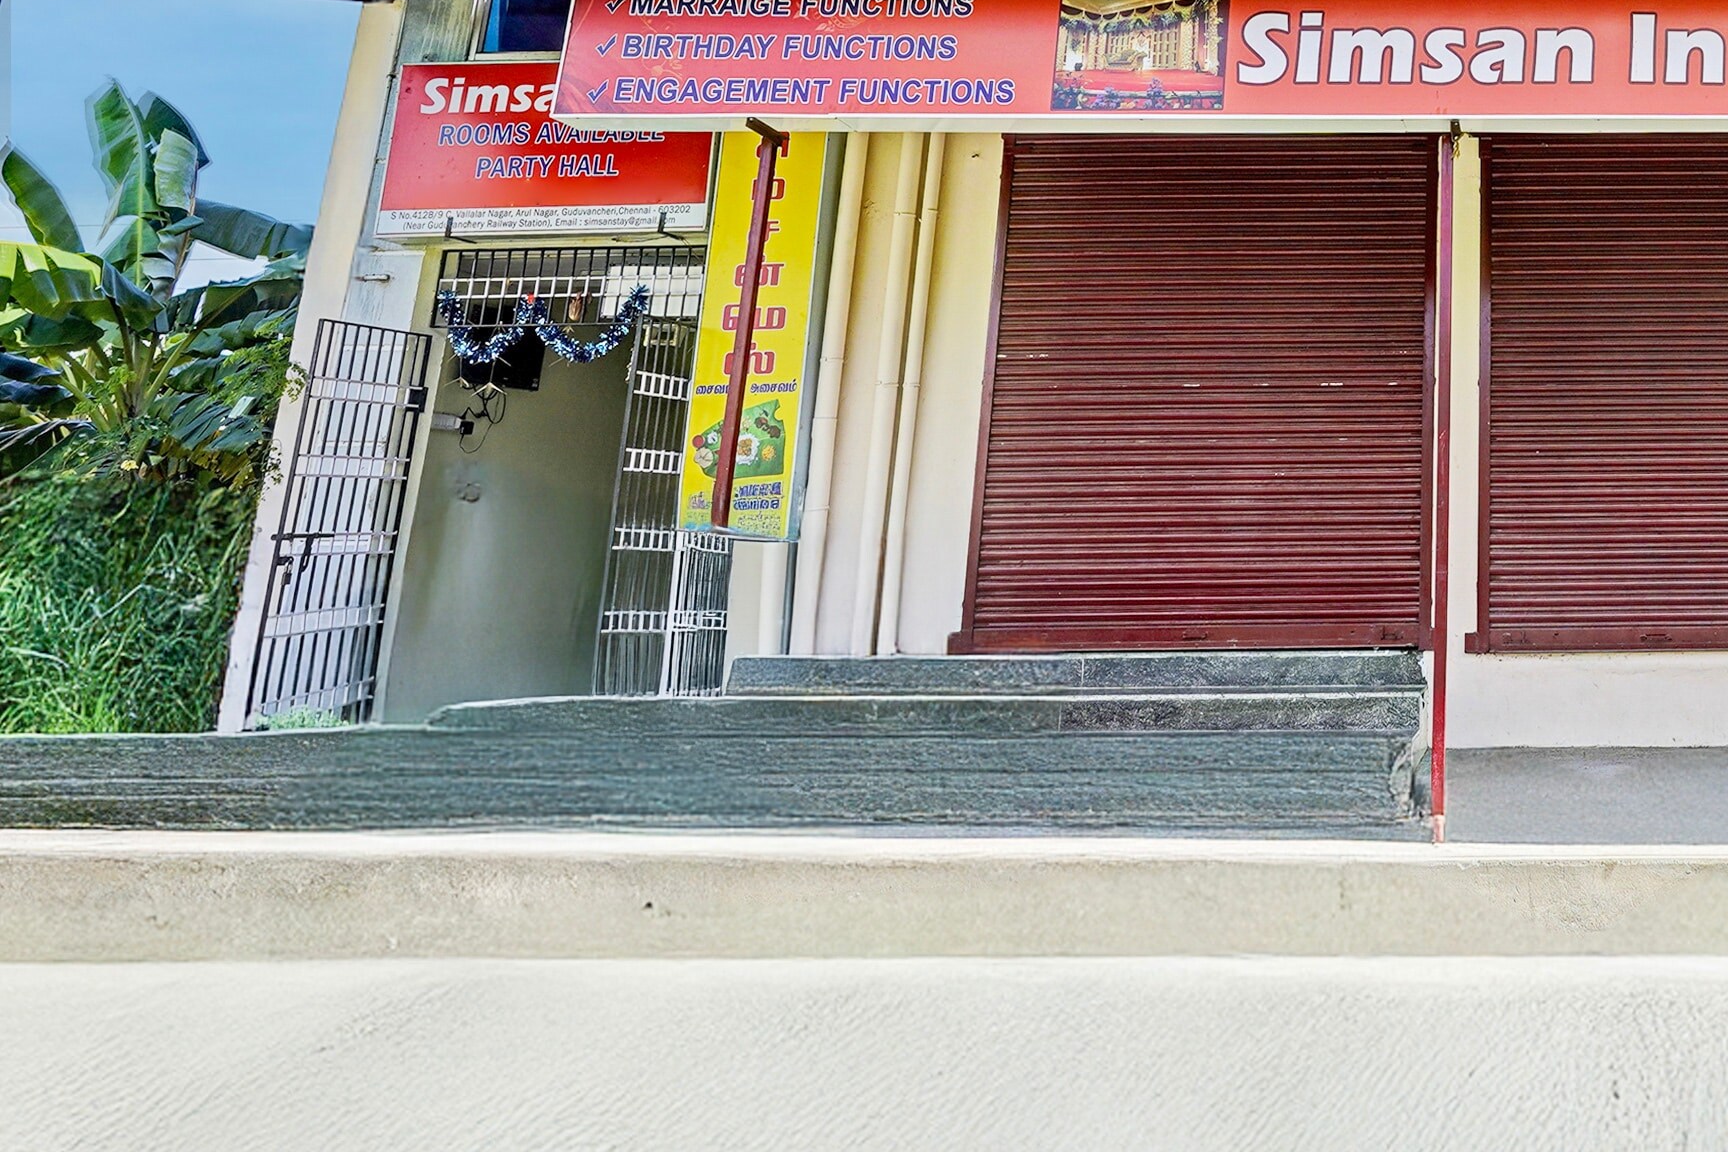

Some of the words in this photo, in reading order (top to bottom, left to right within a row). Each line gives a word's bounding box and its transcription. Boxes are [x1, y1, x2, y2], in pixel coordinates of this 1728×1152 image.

[621, 33, 776, 60] BIRTHDAY
[782, 32, 958, 61] FUNCTIONS
[1236, 10, 1596, 86] Simsan
[613, 76, 832, 105] ENGAGEMENT
[838, 76, 1017, 105] FUNCTIONS
[437, 123, 531, 146] ROOMS
[474, 155, 554, 179] PARTY
[558, 154, 619, 177] HALL
[390, 211, 397, 220] S
[456, 209, 486, 218] Vallalar
[515, 207, 532, 217] Arul
[658, 204, 691, 214] 603202
[403, 220, 426, 231] (Near
[486, 217, 517, 228] Railway
[555, 217, 577, 227] Email
